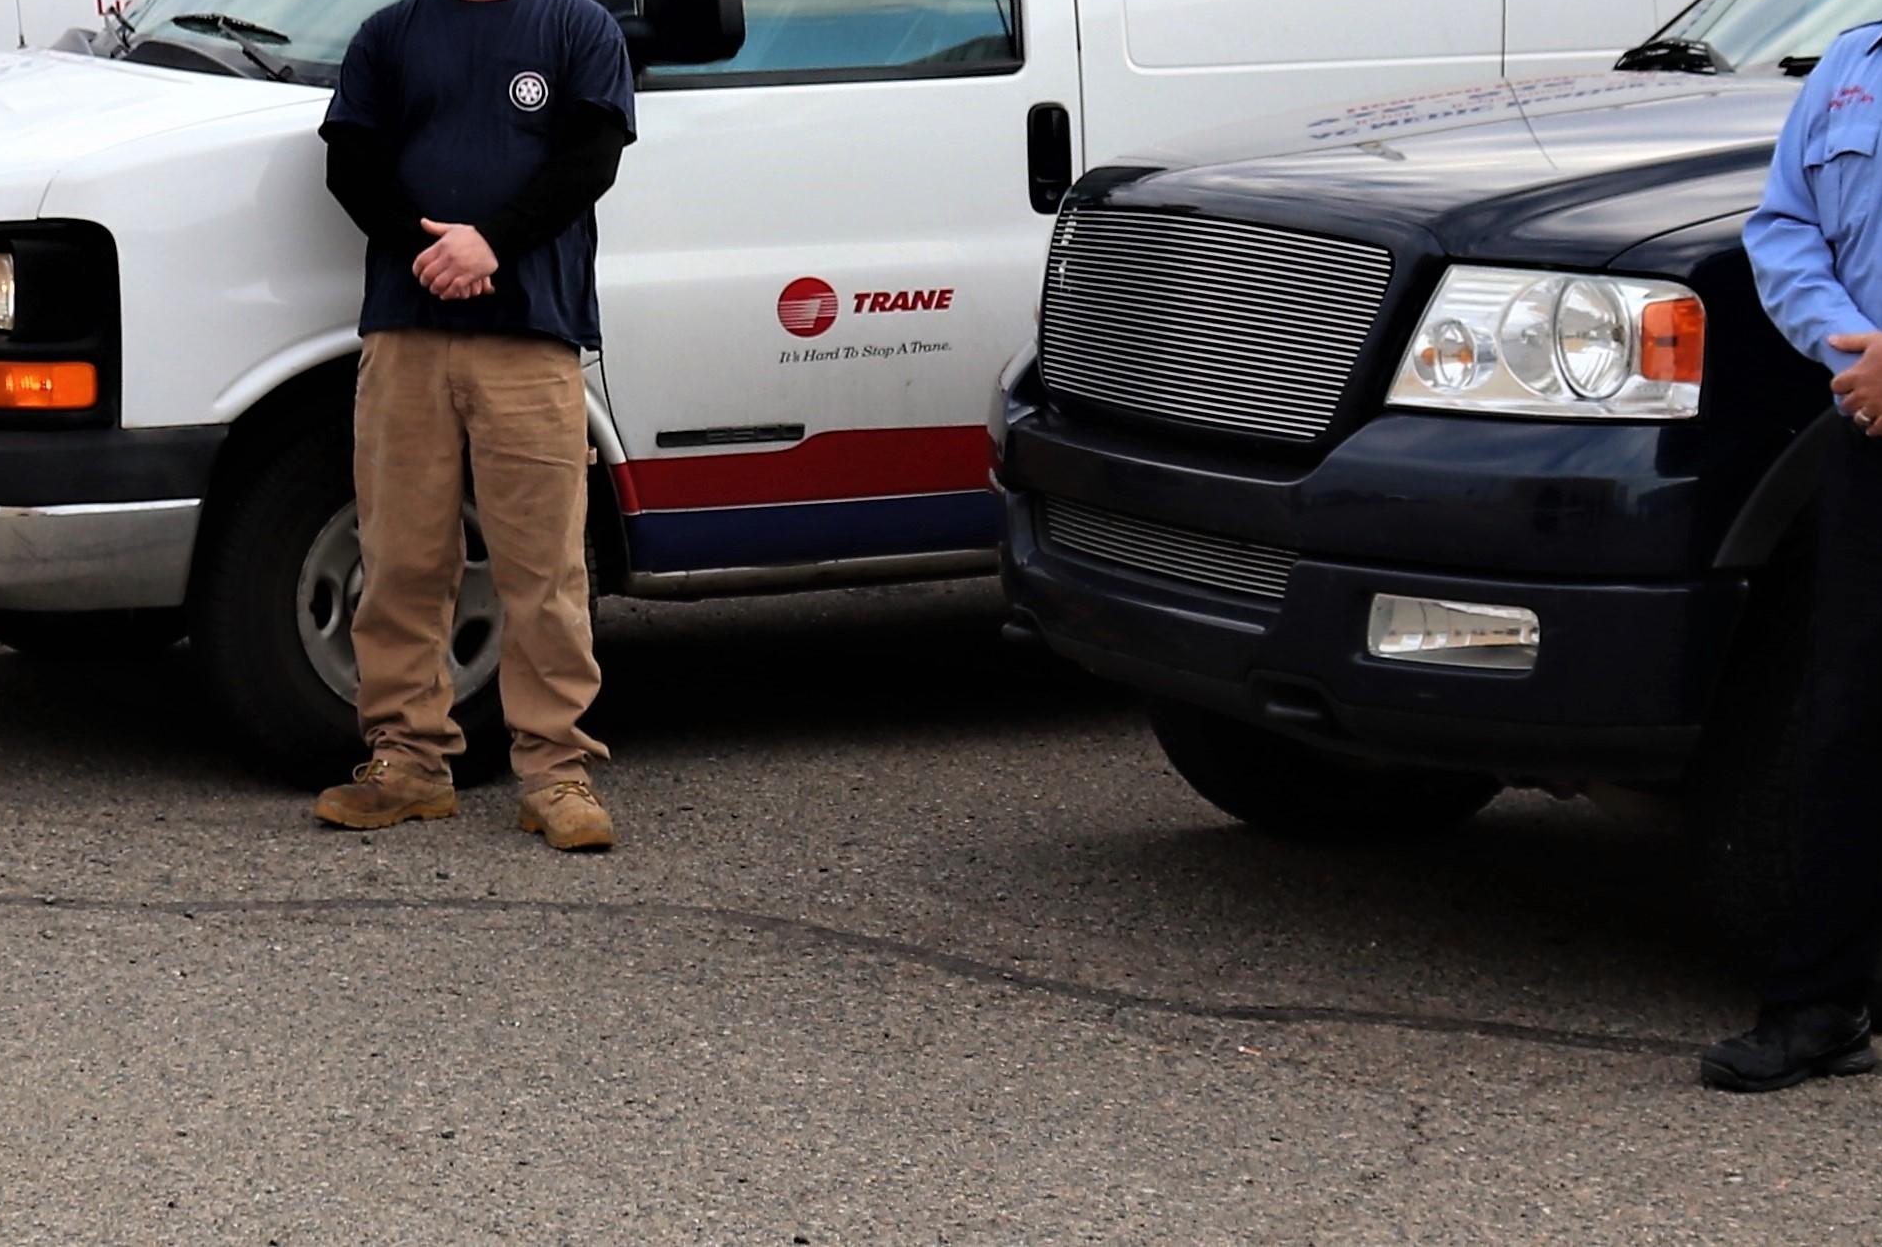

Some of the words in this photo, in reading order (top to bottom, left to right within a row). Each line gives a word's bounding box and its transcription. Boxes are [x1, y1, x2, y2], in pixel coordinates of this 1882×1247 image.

[854, 289, 954, 314] TRANE
[779, 351, 799, 364] It's
[803, 347, 841, 362] Hard
[844, 346, 859, 360] To
[862, 344, 895, 359] Stop
[896, 343, 908, 355] A
[910, 340, 951, 354] Trane.
